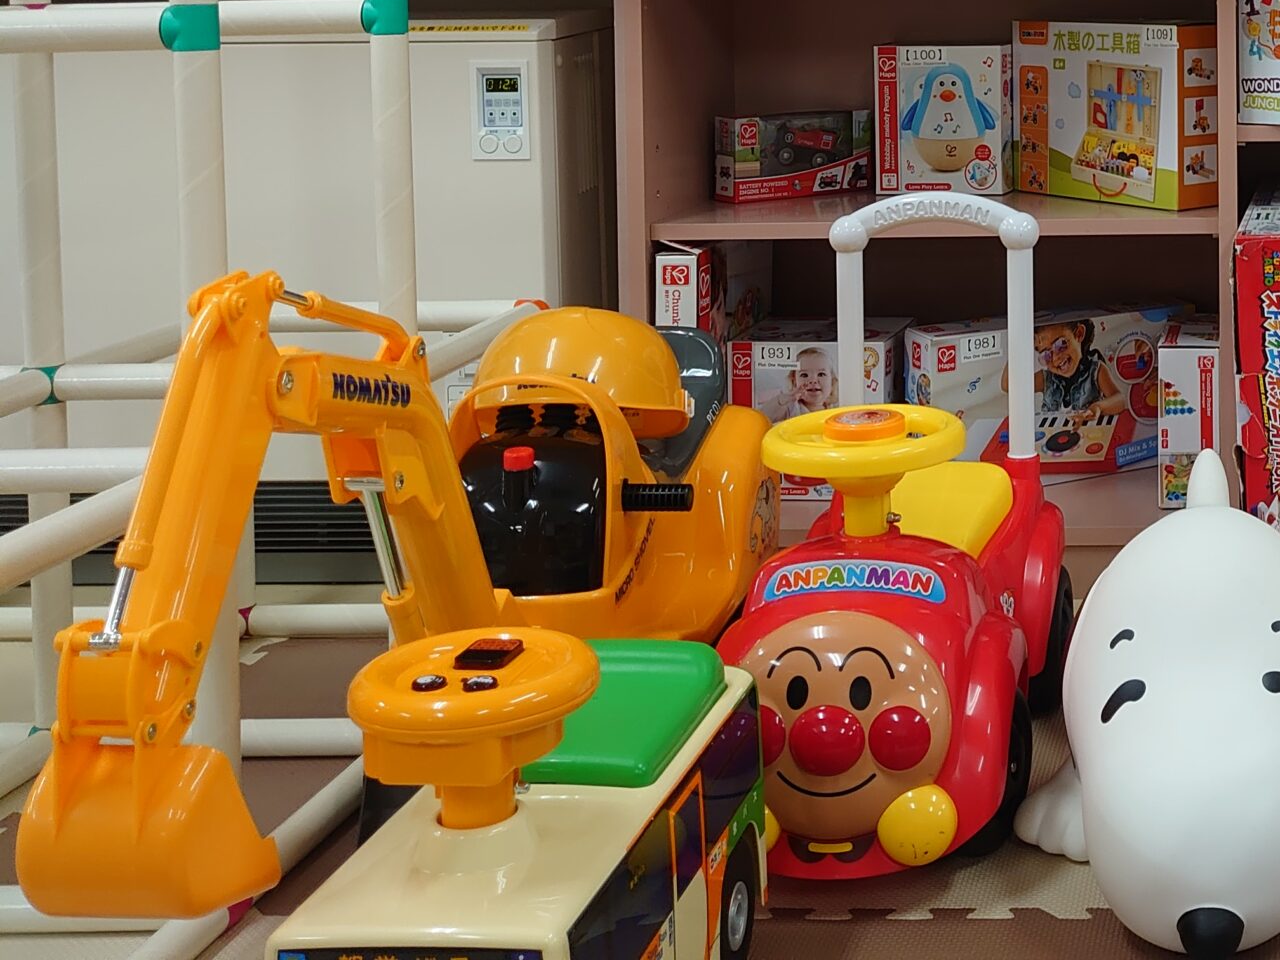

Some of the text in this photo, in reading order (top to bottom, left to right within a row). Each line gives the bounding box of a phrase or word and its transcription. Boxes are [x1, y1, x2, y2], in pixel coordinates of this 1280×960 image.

[1053, 29, 1141, 54] 木製の工具箱
[1146, 28, 1173, 40] 【109】
[905, 49, 942, 62] 【100】
[873, 199, 991, 227] ANPANMAN
[967, 335, 997, 351] 【98】
[761, 347, 791, 360] 【93】
[939, 363, 955, 371] Hape
[333, 373, 411, 408] KOMATSU
[1119, 448, 1127, 456] DJ
[615, 517, 656, 604] MICRO SHOVEL
[775, 565, 934, 595] ANPANMAN
